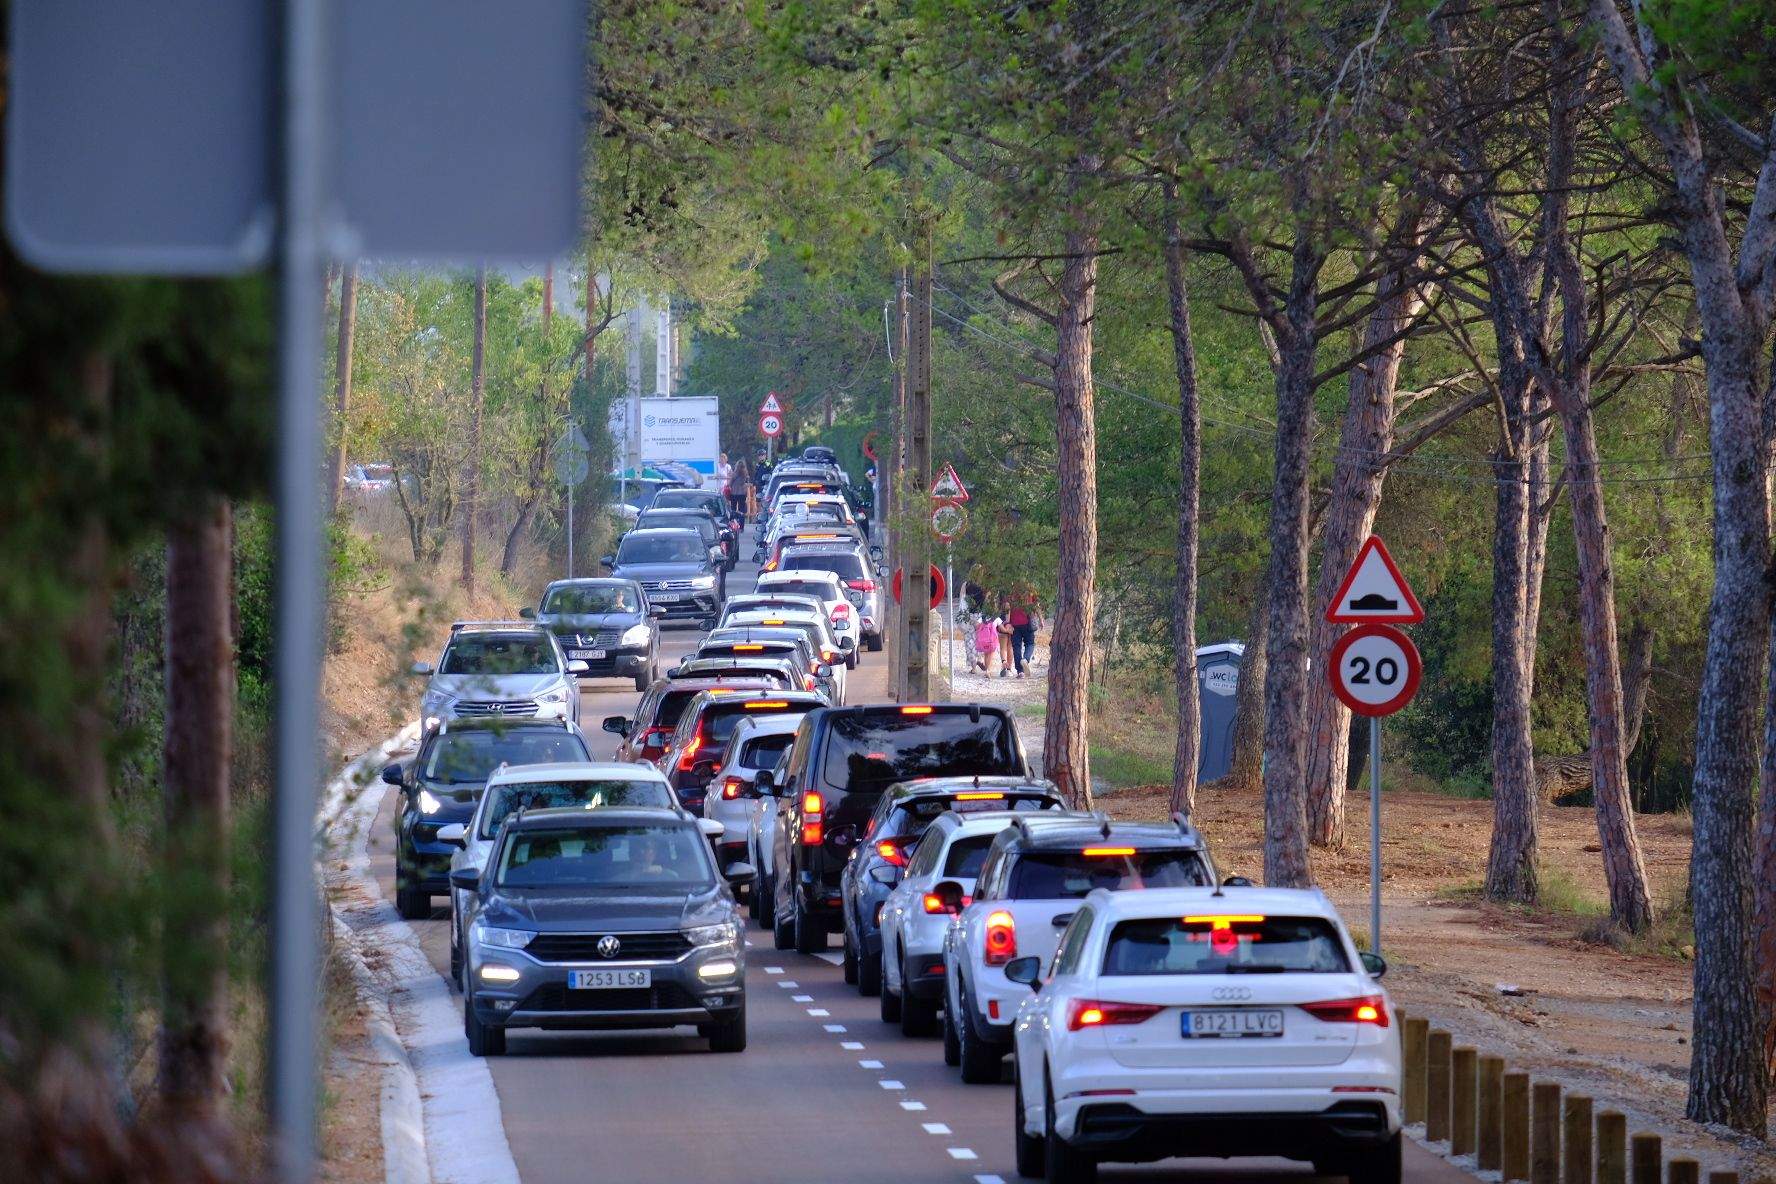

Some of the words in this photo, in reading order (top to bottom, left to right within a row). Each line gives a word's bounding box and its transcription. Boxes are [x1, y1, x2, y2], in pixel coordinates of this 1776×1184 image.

[765, 421, 778, 429] 20
[1350, 656, 1398, 685] 20
[579, 973, 613, 986] 1253
[618, 972, 645, 986] LSB
[1194, 1015, 1237, 1030] 8121
[1245, 1015, 1278, 1030] LVC
